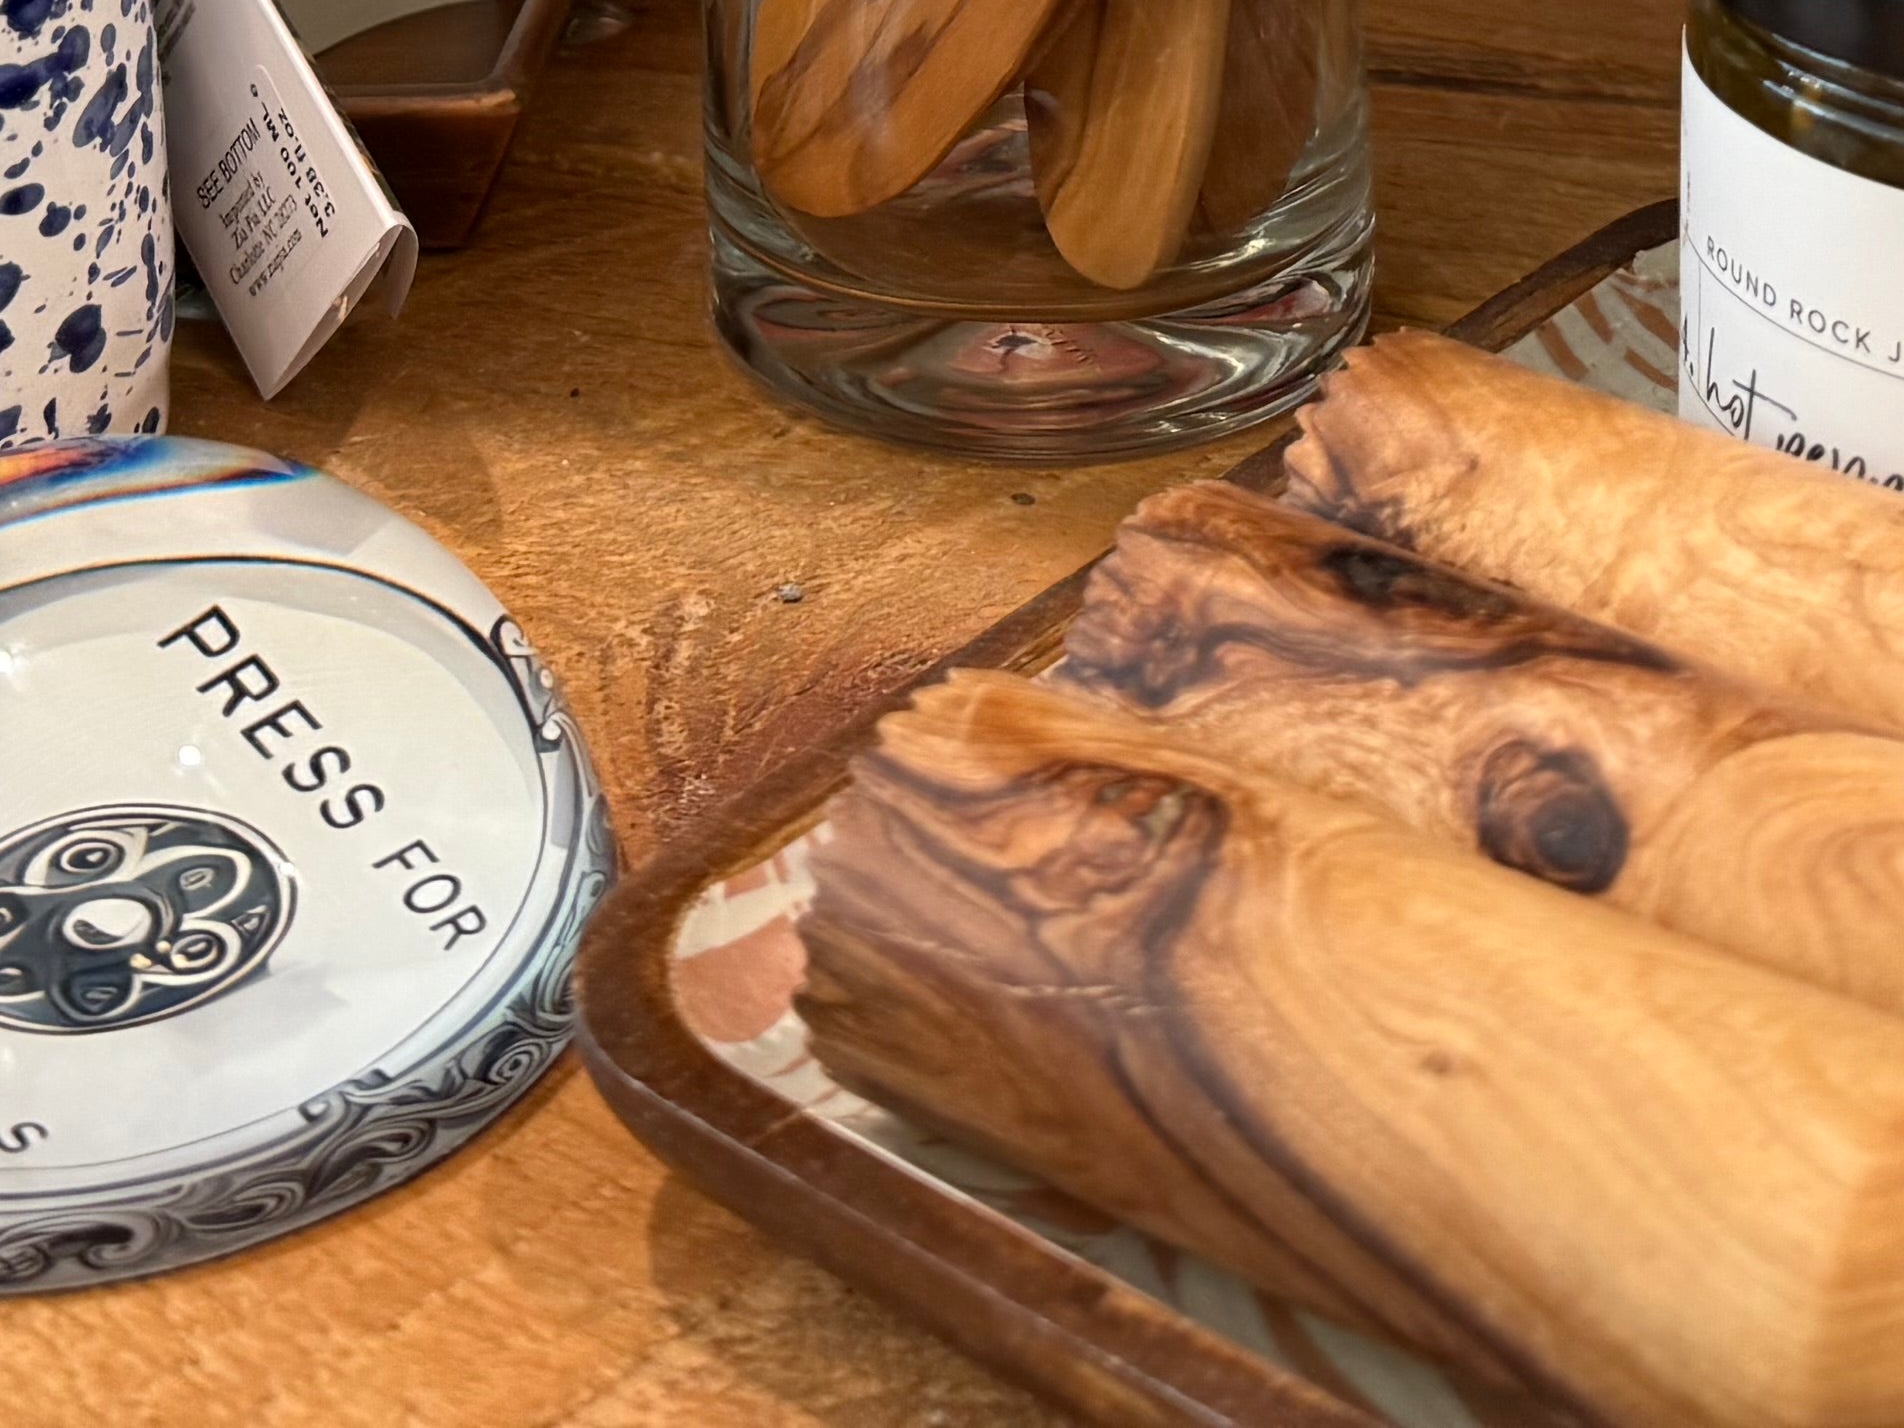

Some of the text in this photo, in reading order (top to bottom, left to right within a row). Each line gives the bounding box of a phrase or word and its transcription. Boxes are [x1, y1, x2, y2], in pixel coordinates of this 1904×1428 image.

[195, 117, 262, 210] SEE BOTTOM
[1705, 234, 1778, 310] ROUND
[1787, 297, 1872, 355] ROCK
[154, 602, 489, 952] PRESS FOR
